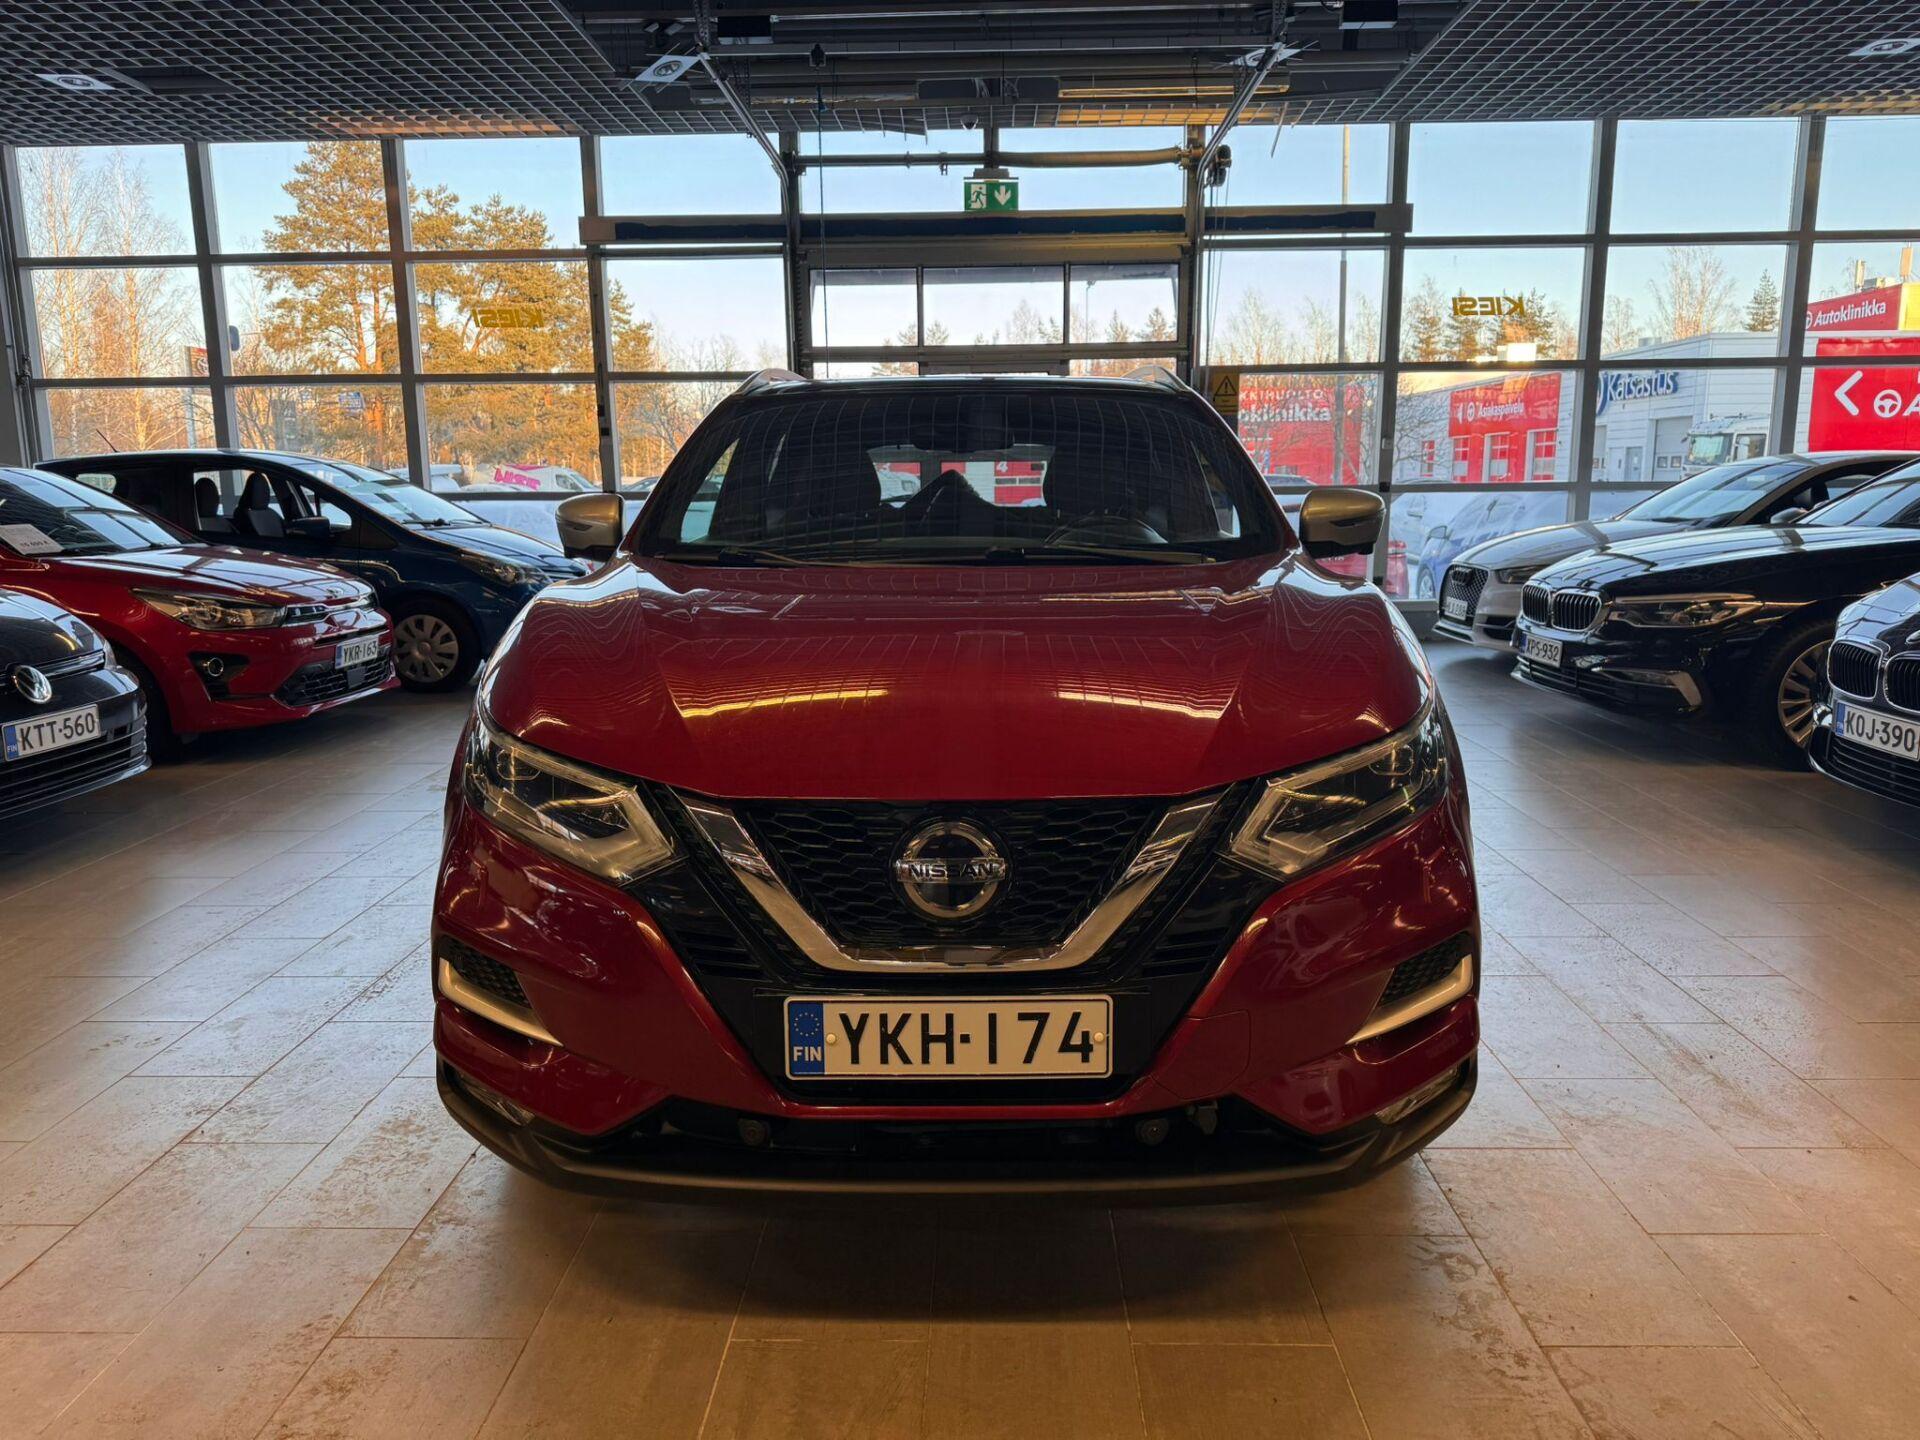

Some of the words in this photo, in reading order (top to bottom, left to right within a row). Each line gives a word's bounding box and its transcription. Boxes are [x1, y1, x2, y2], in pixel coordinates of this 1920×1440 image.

[1813, 299, 1887, 327] Autoklinikka
[1607, 371, 1673, 400] Katsastus
[20, 712, 95, 750] KTT-560
[1846, 711, 1915, 752] KOJ-390
[908, 862, 994, 879] NISSAN
[839, 1012, 1094, 1065] YKH-174
[793, 1046, 821, 1061] FIN
